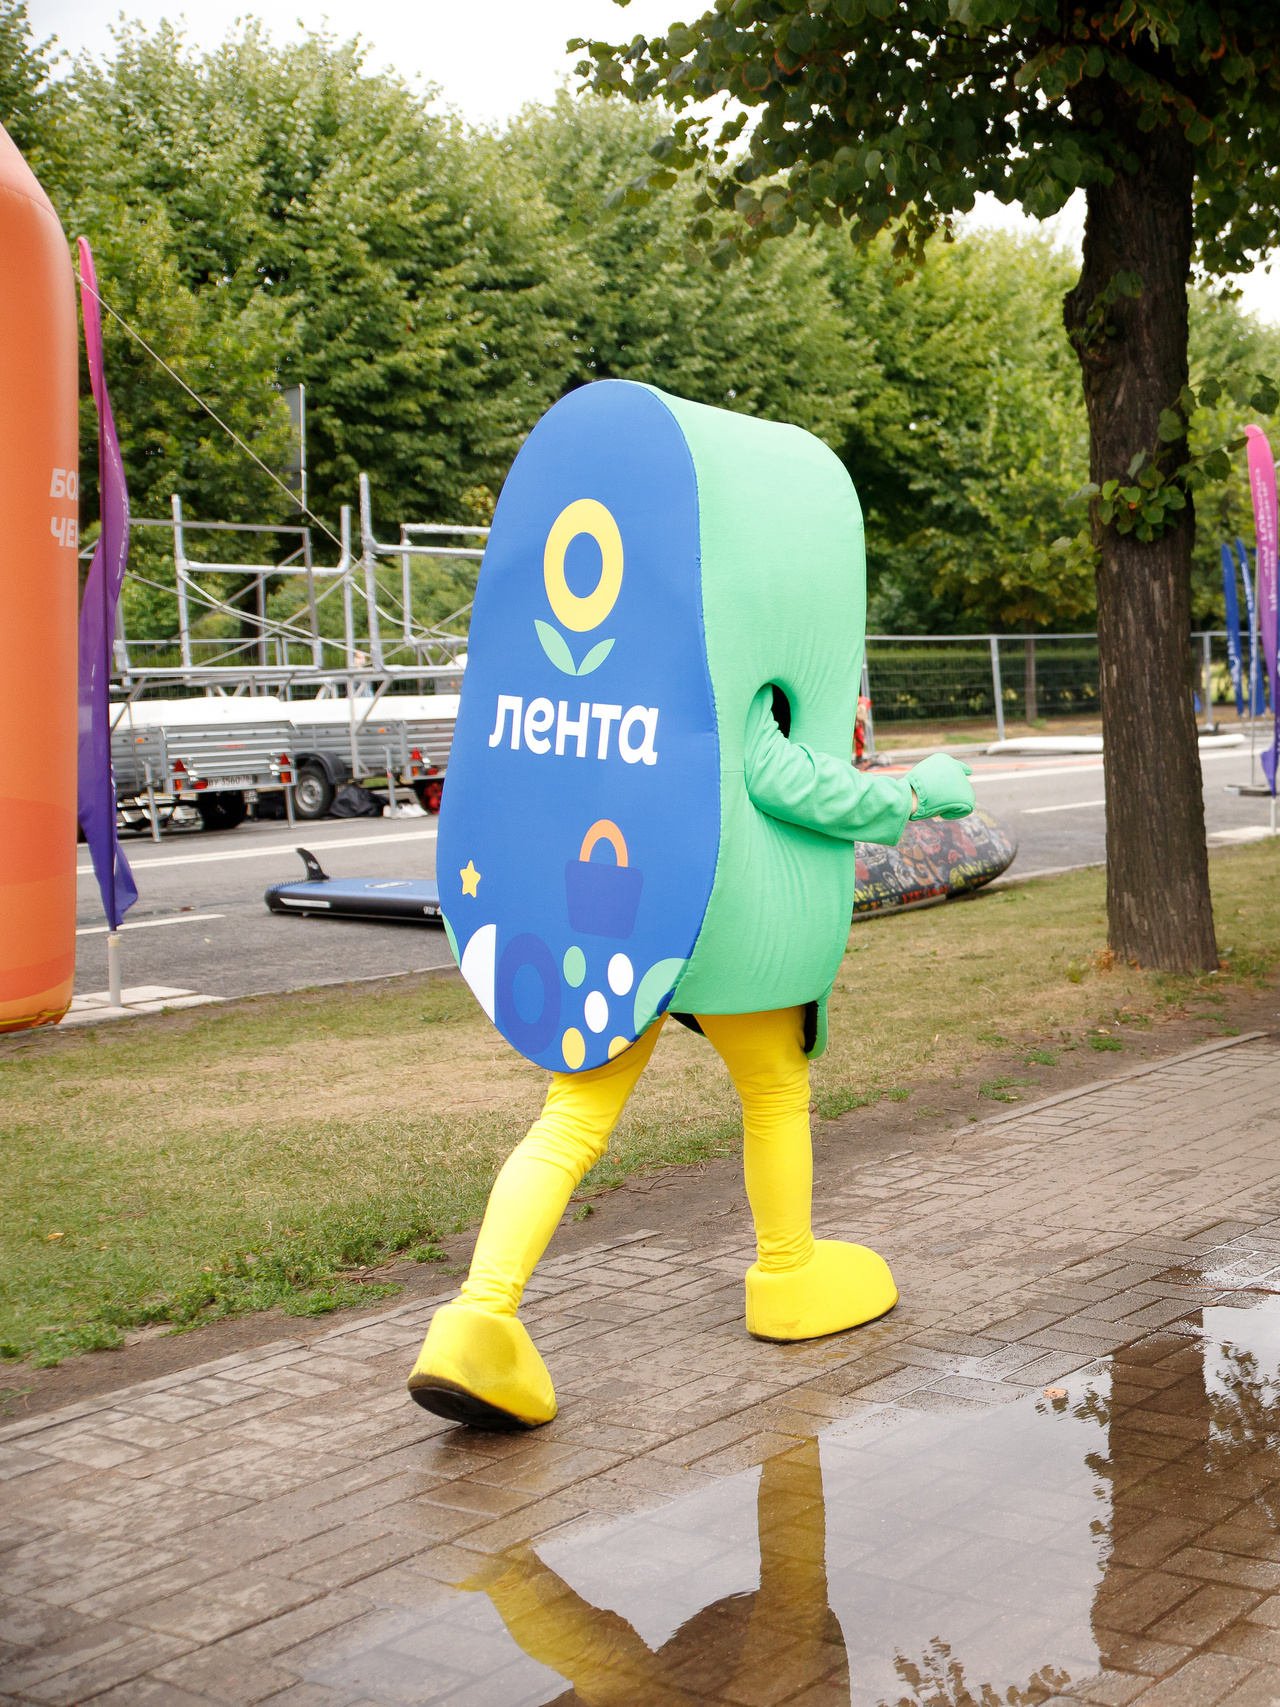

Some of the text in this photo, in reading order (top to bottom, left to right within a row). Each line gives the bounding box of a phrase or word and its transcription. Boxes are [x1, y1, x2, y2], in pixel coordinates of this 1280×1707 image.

[49, 468, 79, 501] БО
[50, 516, 78, 548] ЧЕ
[488, 694, 659, 766] лента
